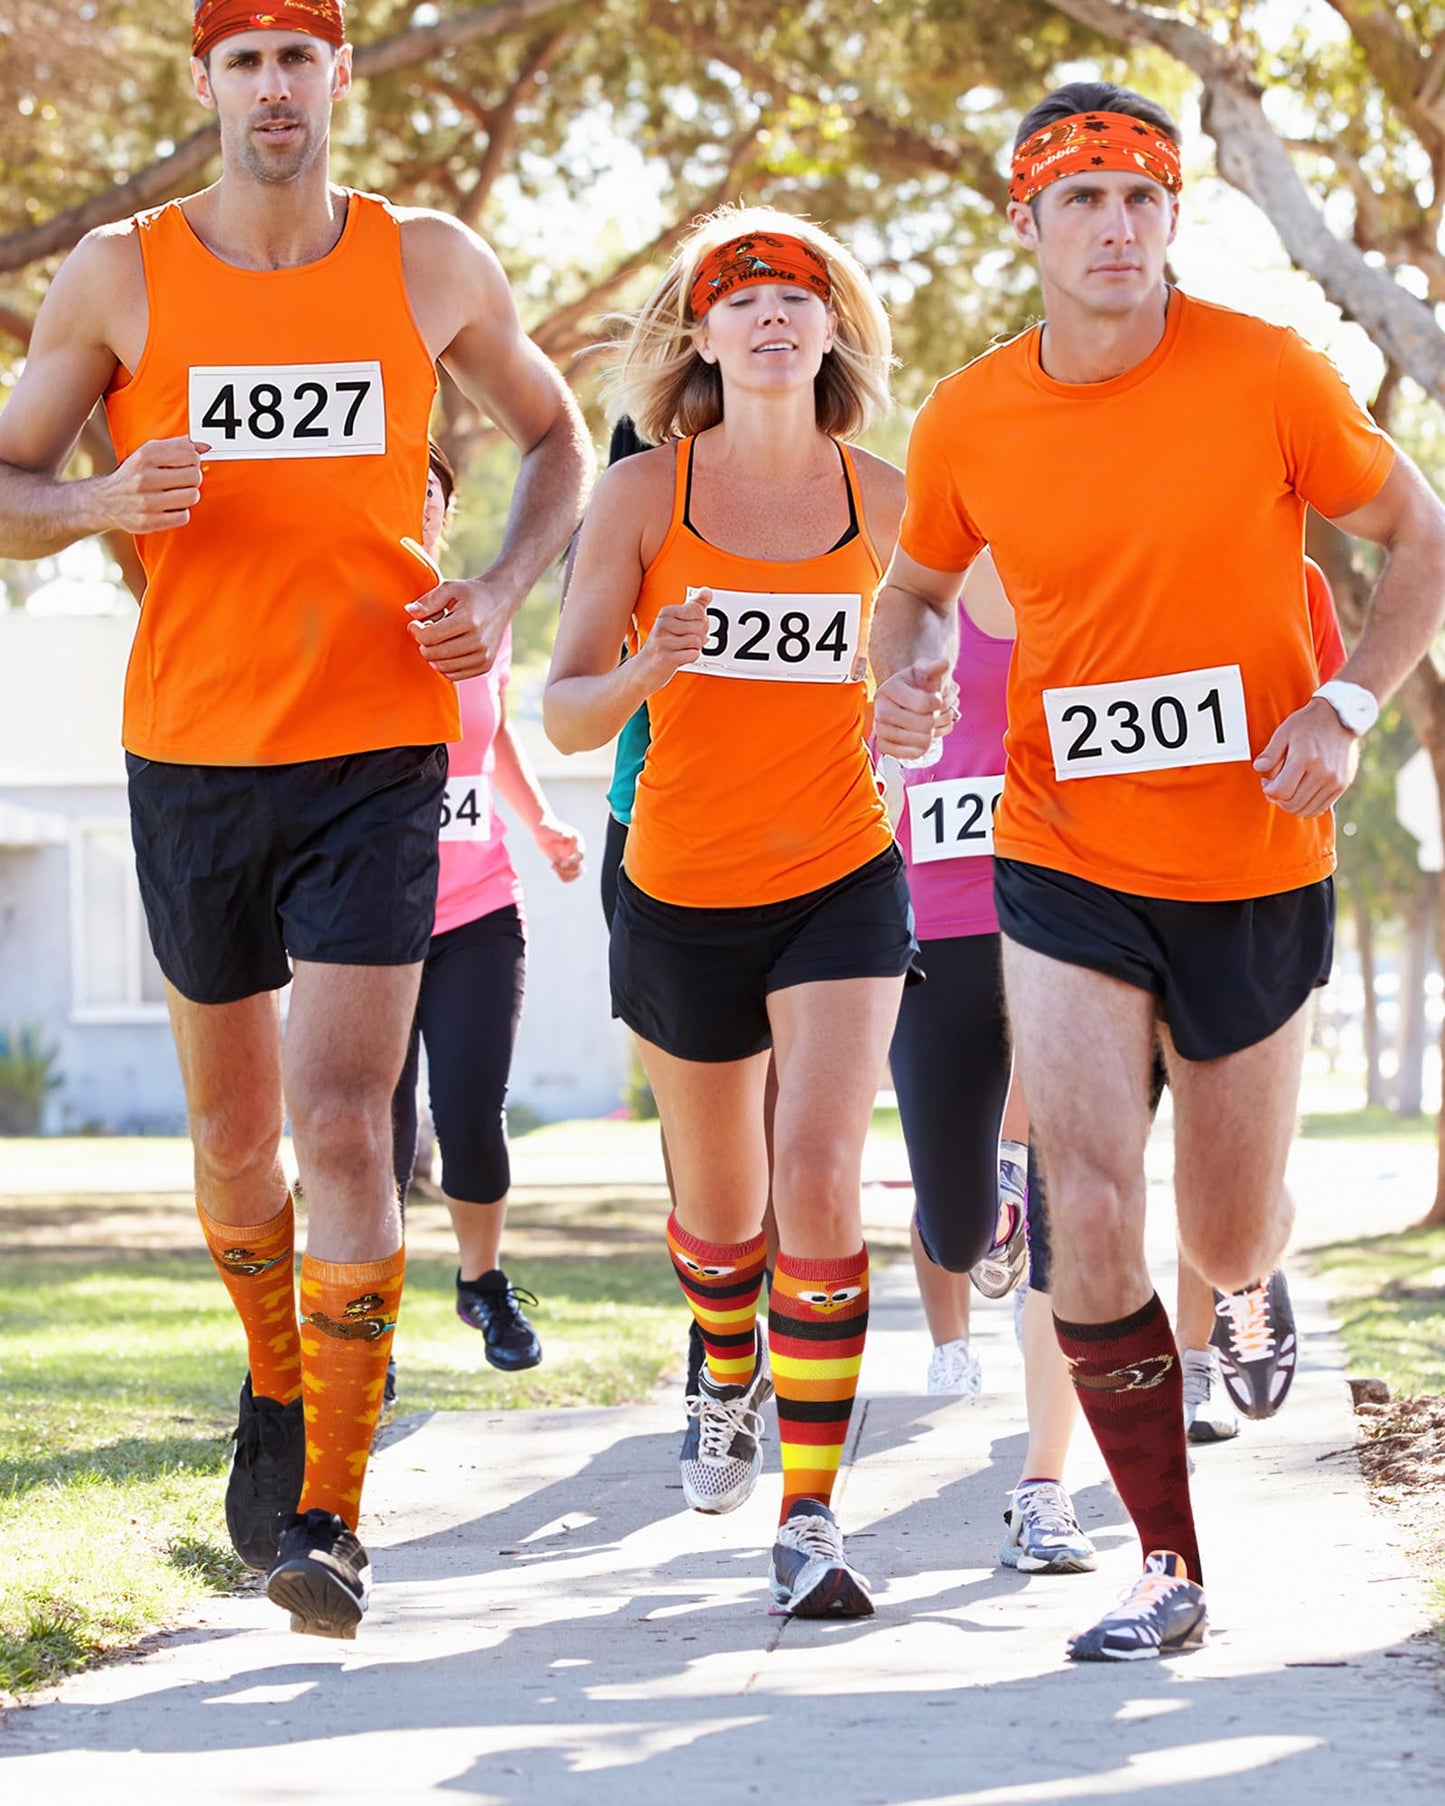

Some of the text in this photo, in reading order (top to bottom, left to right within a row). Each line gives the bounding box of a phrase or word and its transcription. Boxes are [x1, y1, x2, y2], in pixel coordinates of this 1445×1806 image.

[202, 381, 371, 440] 4827
[1061, 688, 1225, 761] 2301
[922, 792, 1001, 844] 12
